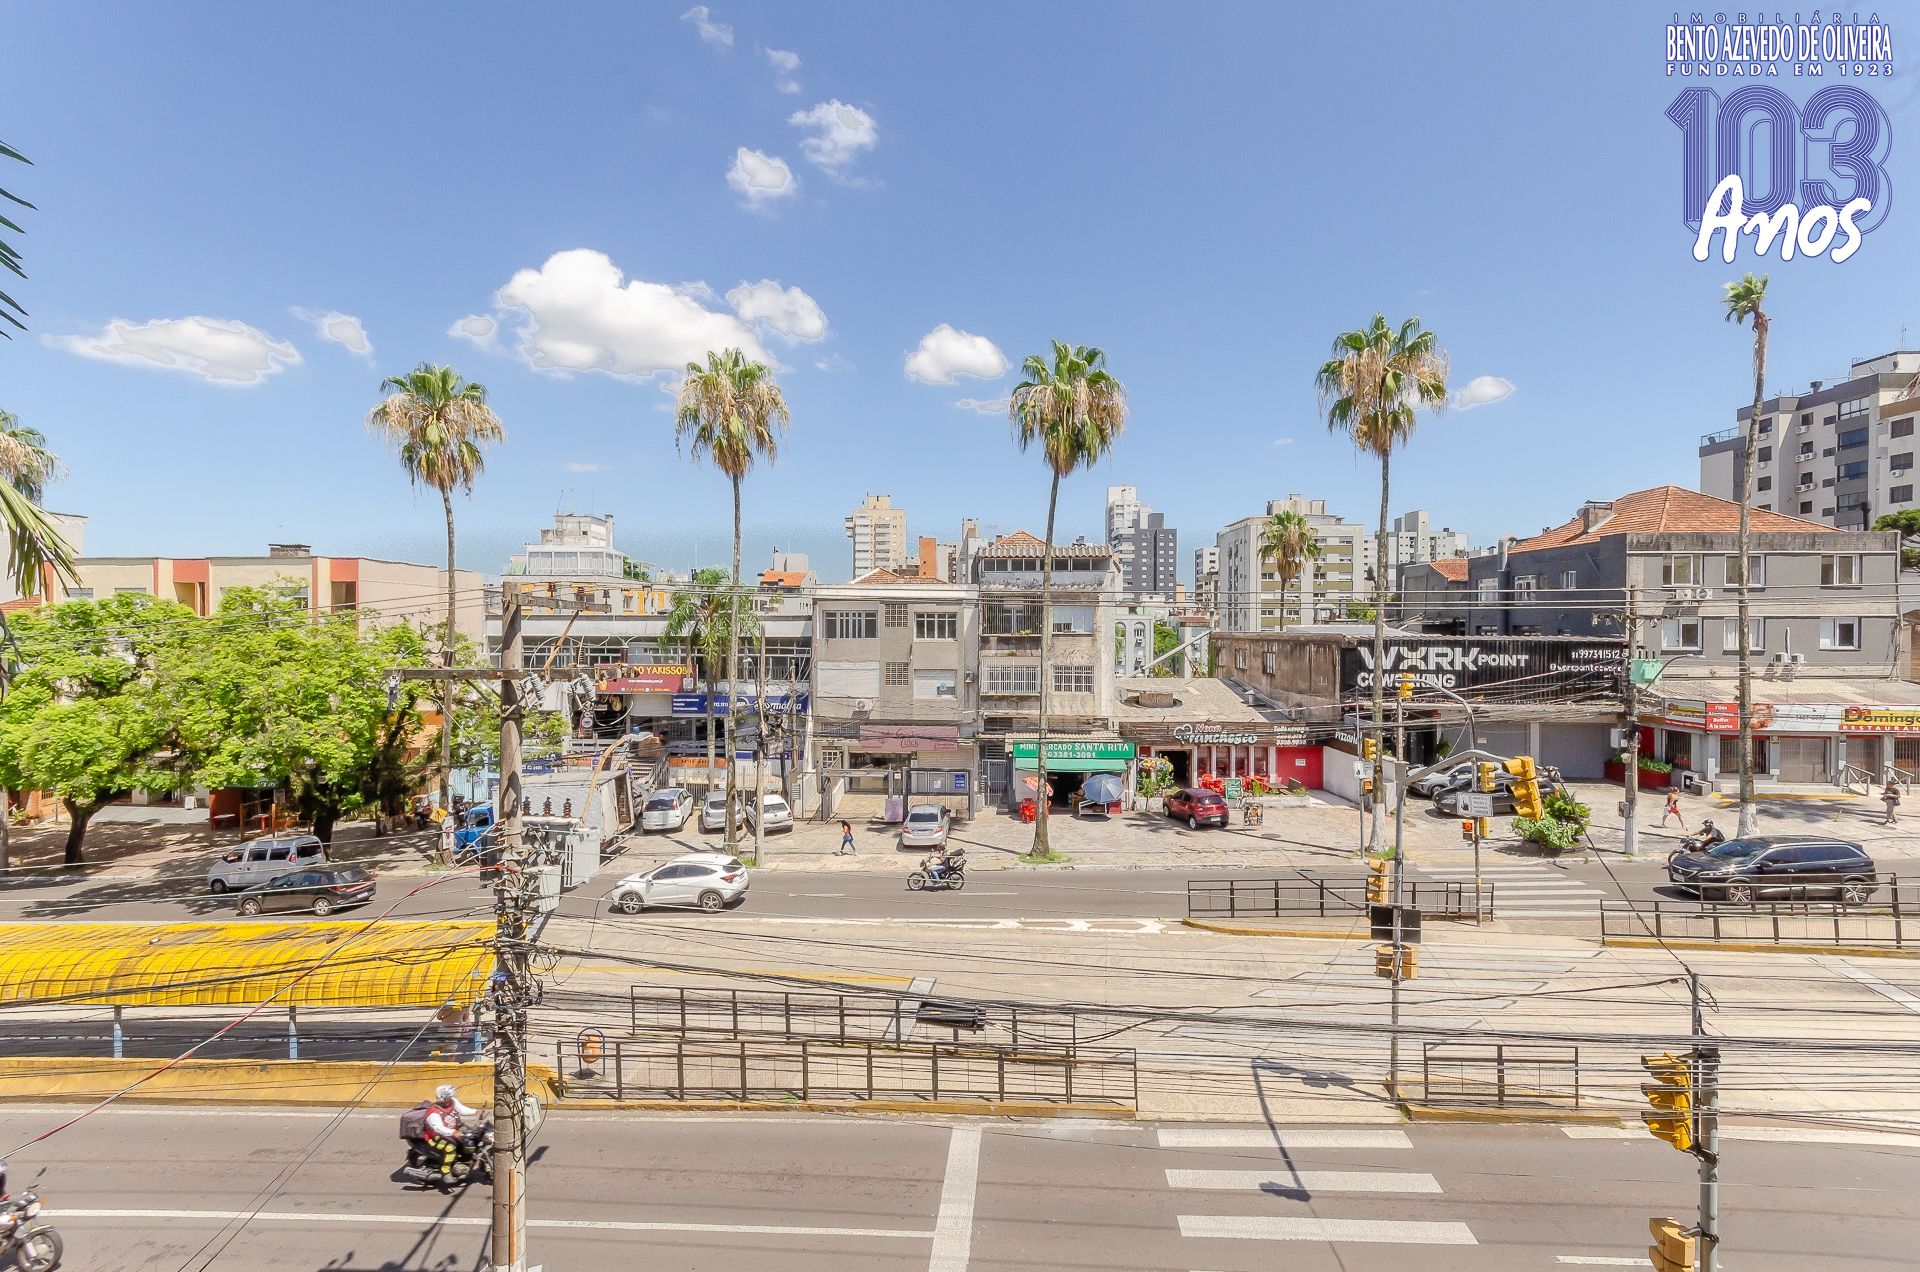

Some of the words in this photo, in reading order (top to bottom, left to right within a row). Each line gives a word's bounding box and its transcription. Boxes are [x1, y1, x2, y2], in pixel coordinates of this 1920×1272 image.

[1478, 654, 1529, 667] POINT
[1074, 743, 1105, 751] SANTA
[1107, 743, 1129, 752] RITA
